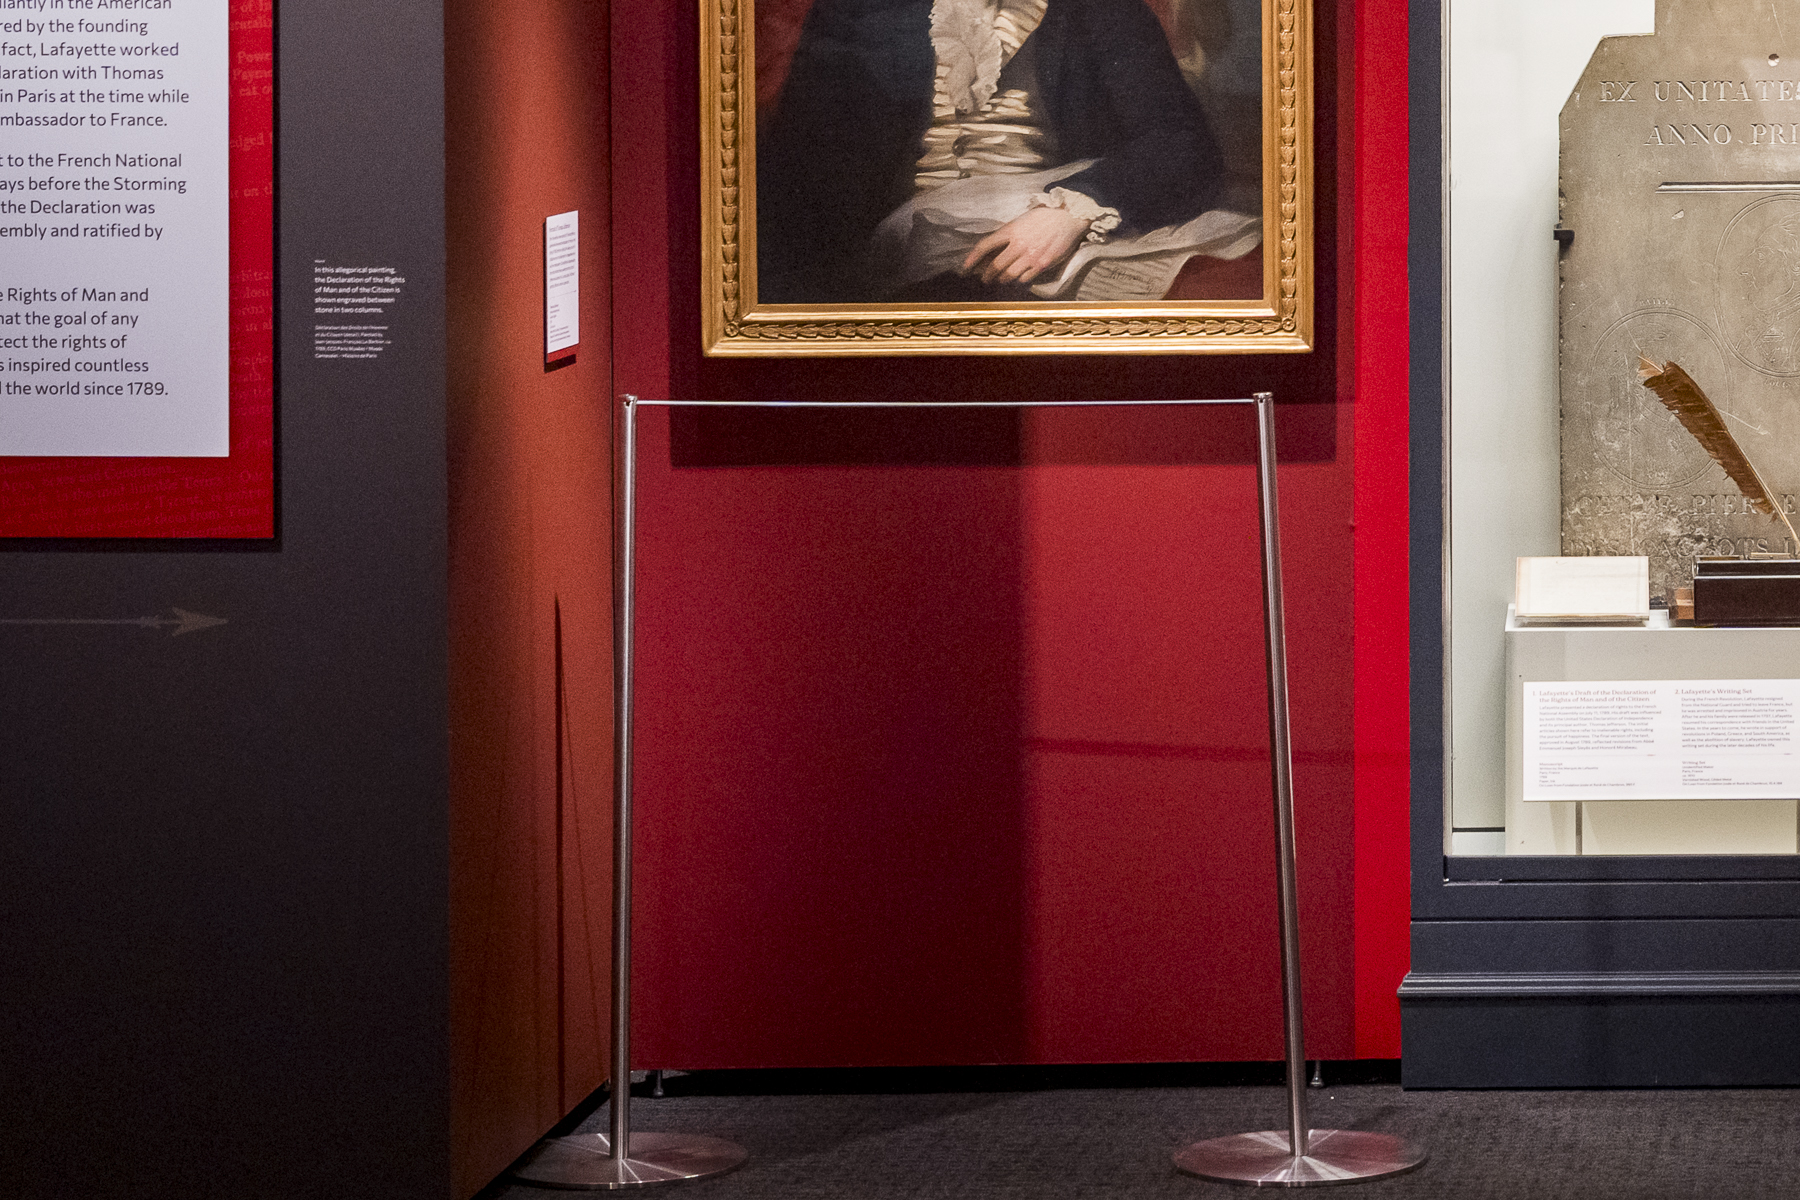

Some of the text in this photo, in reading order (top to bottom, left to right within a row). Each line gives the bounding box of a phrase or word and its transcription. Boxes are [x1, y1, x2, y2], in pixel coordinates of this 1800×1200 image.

[26, 17, 149, 37] by the founding
[1, 41, 179, 59] fact, Lafayette worked
[62, 65, 164, 80] with Thomas
[0, 88, 190, 104] in Paris at the time while
[1599, 81, 1638, 103] EX
[326, 276, 364, 284] Declaration
[364, 276, 372, 284] of
[373, 276, 383, 284] the
[384, 276, 405, 285] Rights
[5, 380, 169, 396] the world since 1789.
[1692, 493, 1796, 515] PIERE
